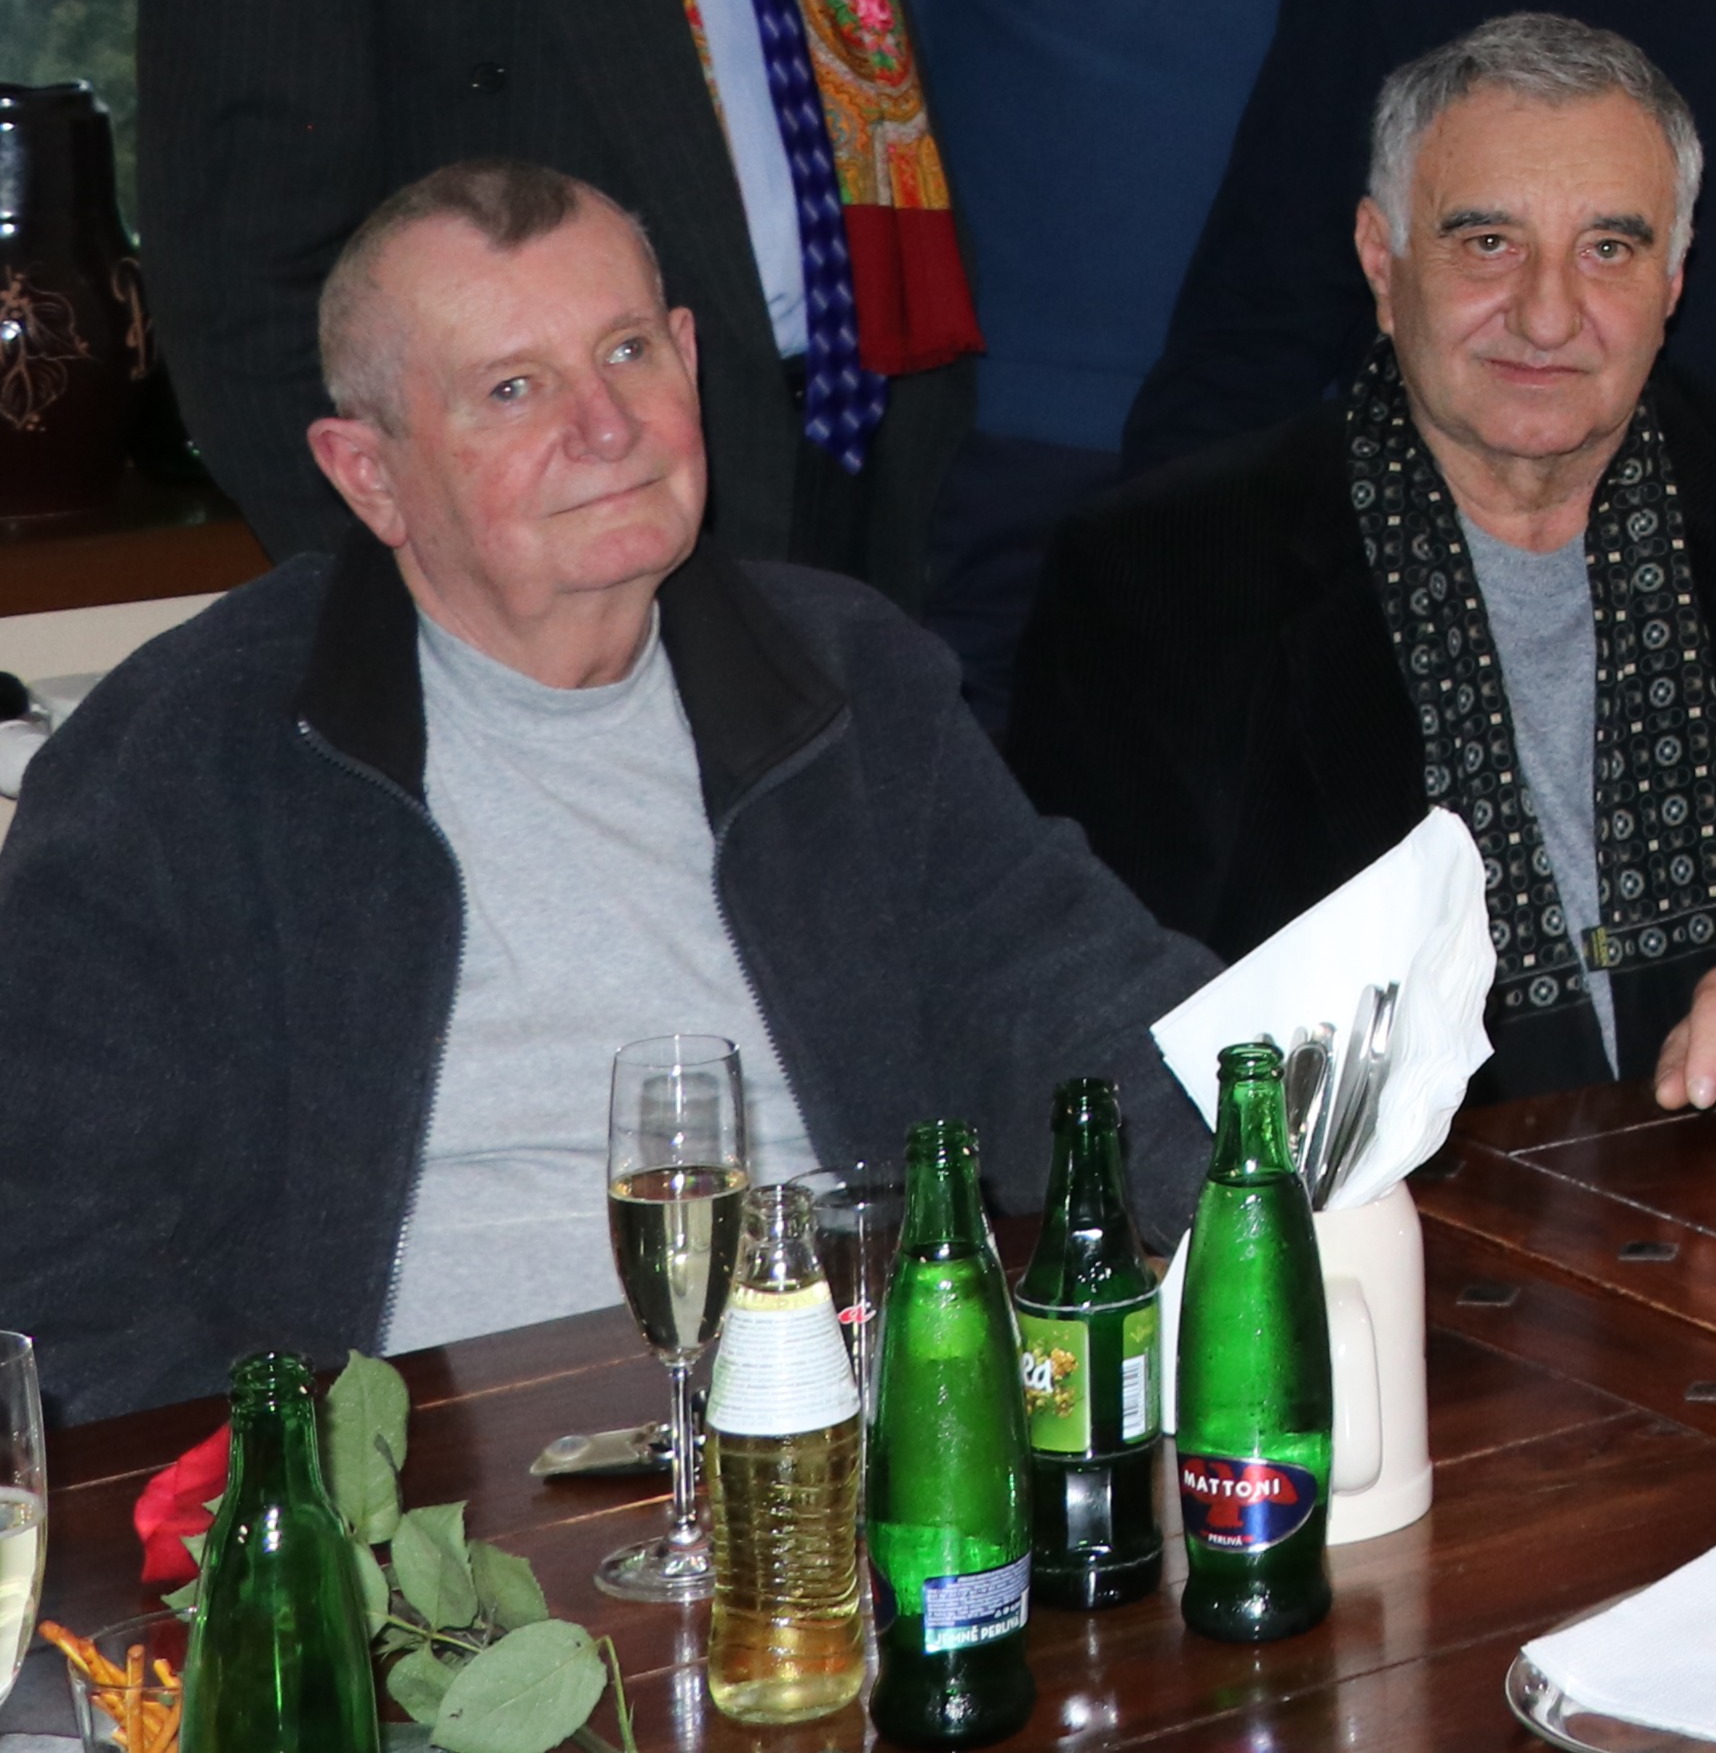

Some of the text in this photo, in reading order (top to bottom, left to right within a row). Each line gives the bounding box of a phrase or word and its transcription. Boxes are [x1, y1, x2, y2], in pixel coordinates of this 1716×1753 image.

[1184, 1469, 1281, 1498] MATTONI
[1208, 1531, 1244, 1547] PERLIVÁ
[935, 1624, 979, 1645] JEMNĚ
